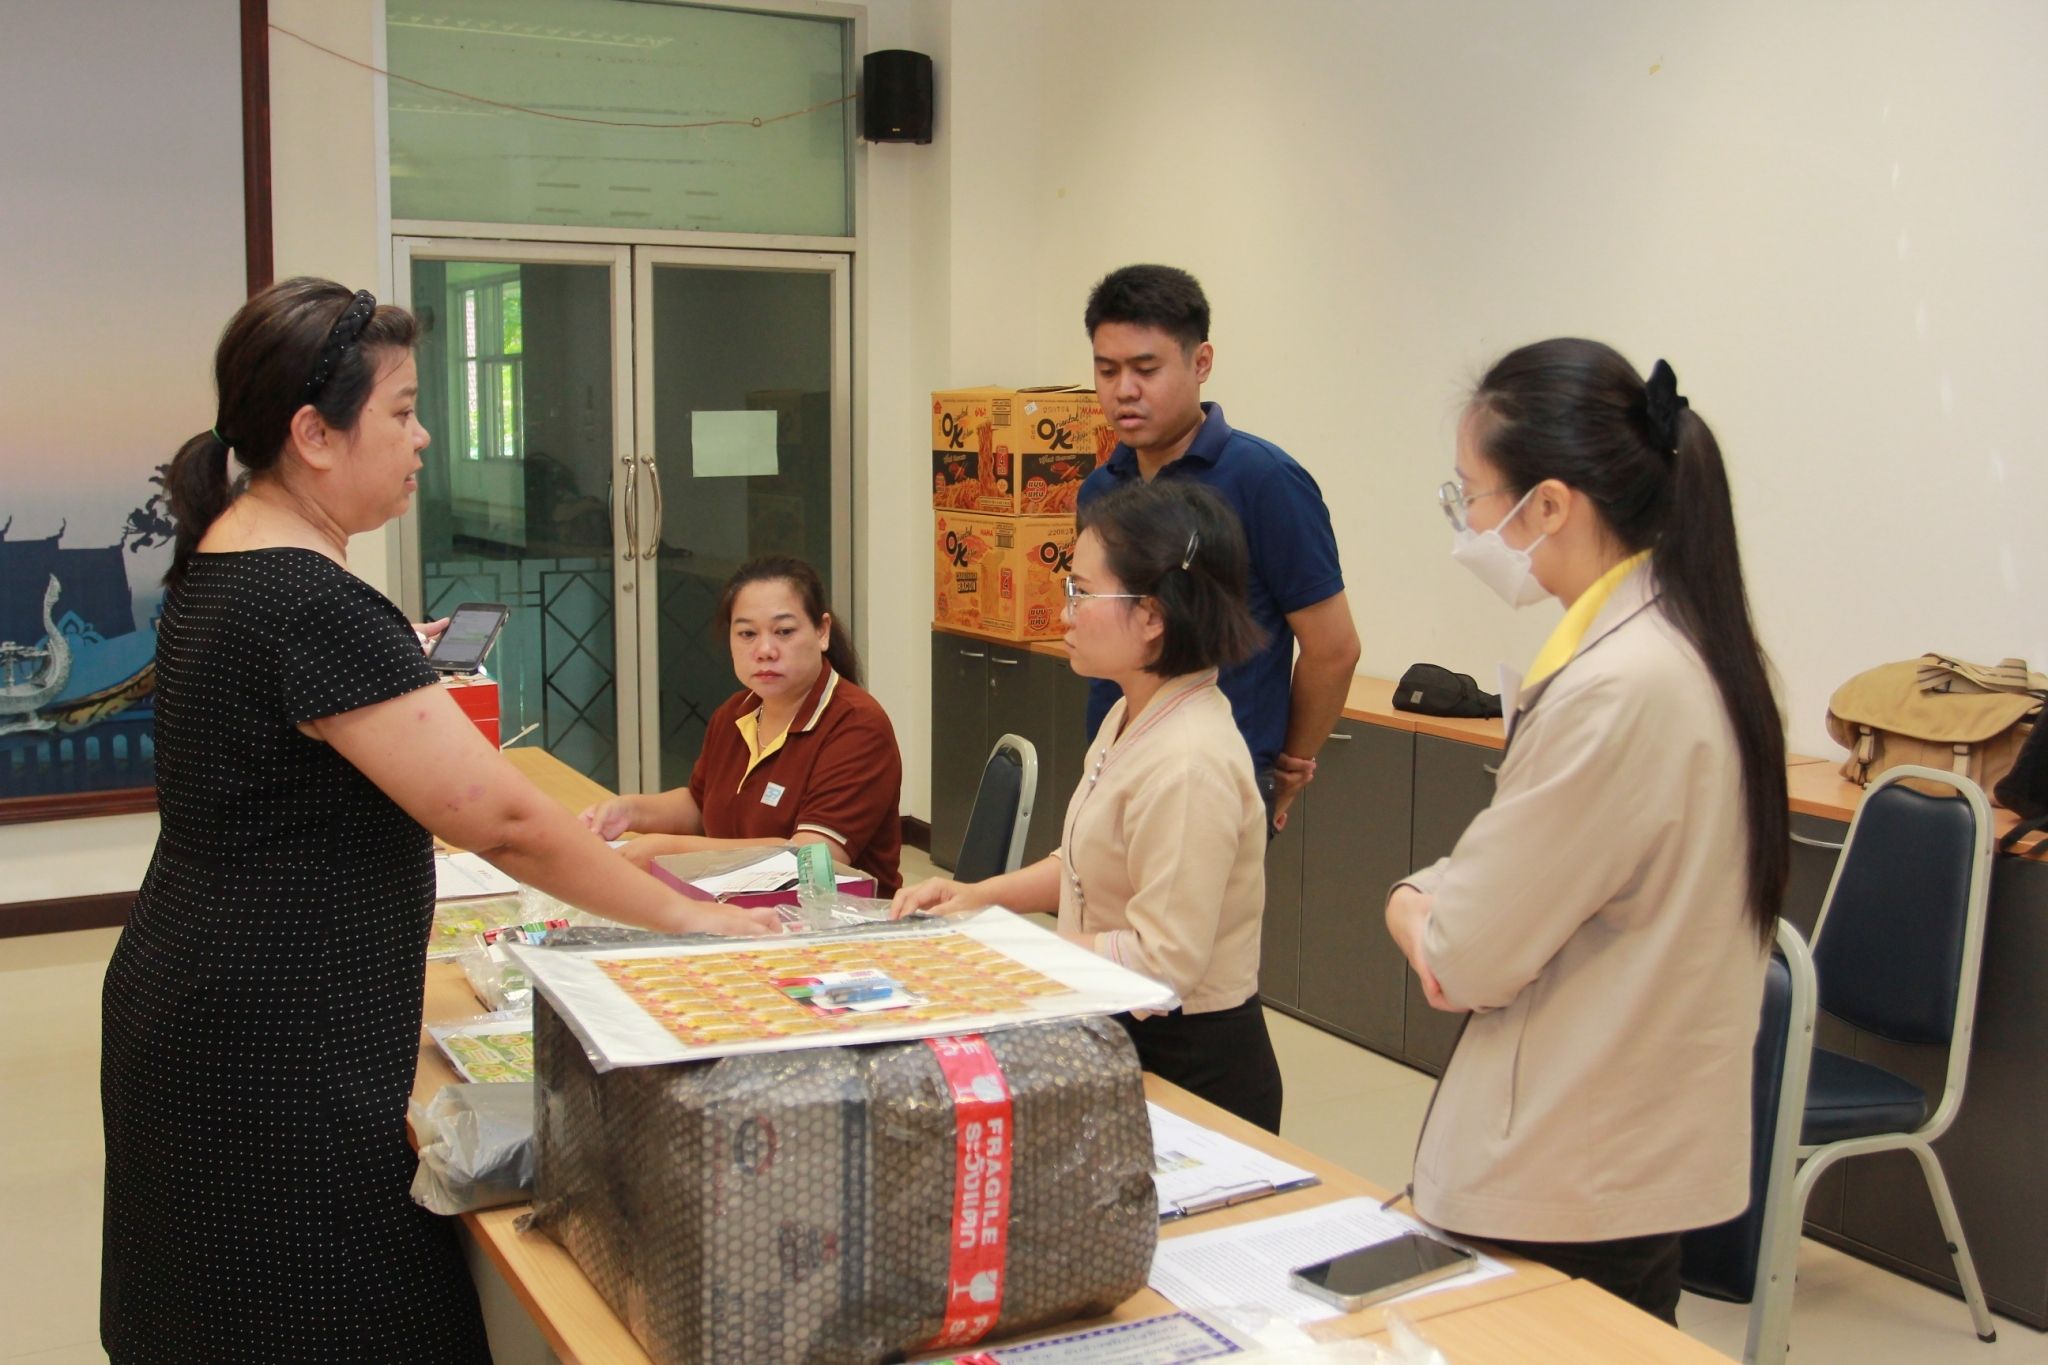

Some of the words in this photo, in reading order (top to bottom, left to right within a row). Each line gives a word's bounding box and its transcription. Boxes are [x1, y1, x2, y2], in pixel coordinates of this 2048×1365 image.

[942, 413, 964, 449] OK
[1037, 418, 1073, 451] OK
[946, 531, 968, 567] OK
[959, 1121, 985, 1249] ระวังแตก
[981, 1117, 1004, 1246] FRAGILE
